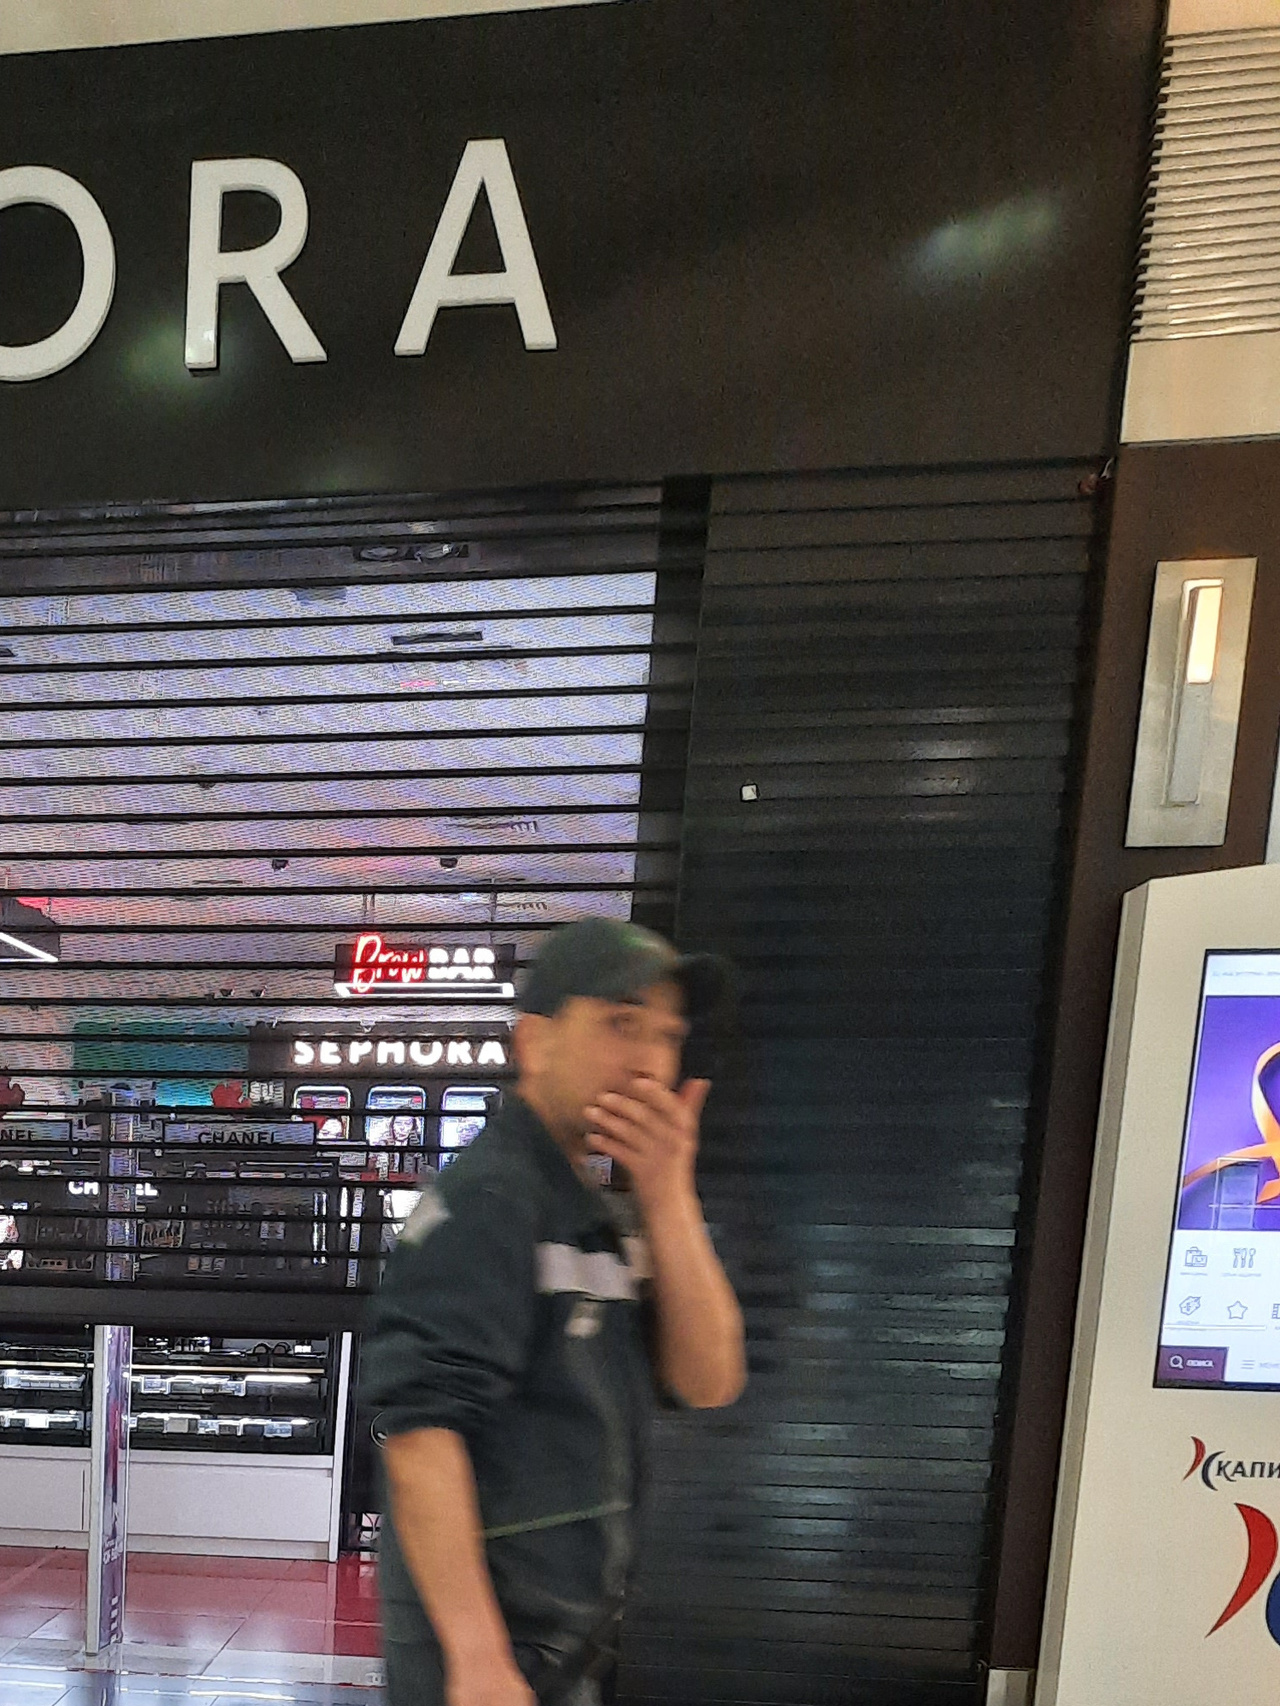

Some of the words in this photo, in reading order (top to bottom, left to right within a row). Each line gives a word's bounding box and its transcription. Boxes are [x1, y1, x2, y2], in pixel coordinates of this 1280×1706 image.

[352, 934, 425, 992] Brow
[428, 947, 496, 980] BAR
[293, 1039, 507, 1066] SEPHORA
[198, 1131, 281, 1145] CHANEL
[68, 1181, 158, 1196] CHEL
